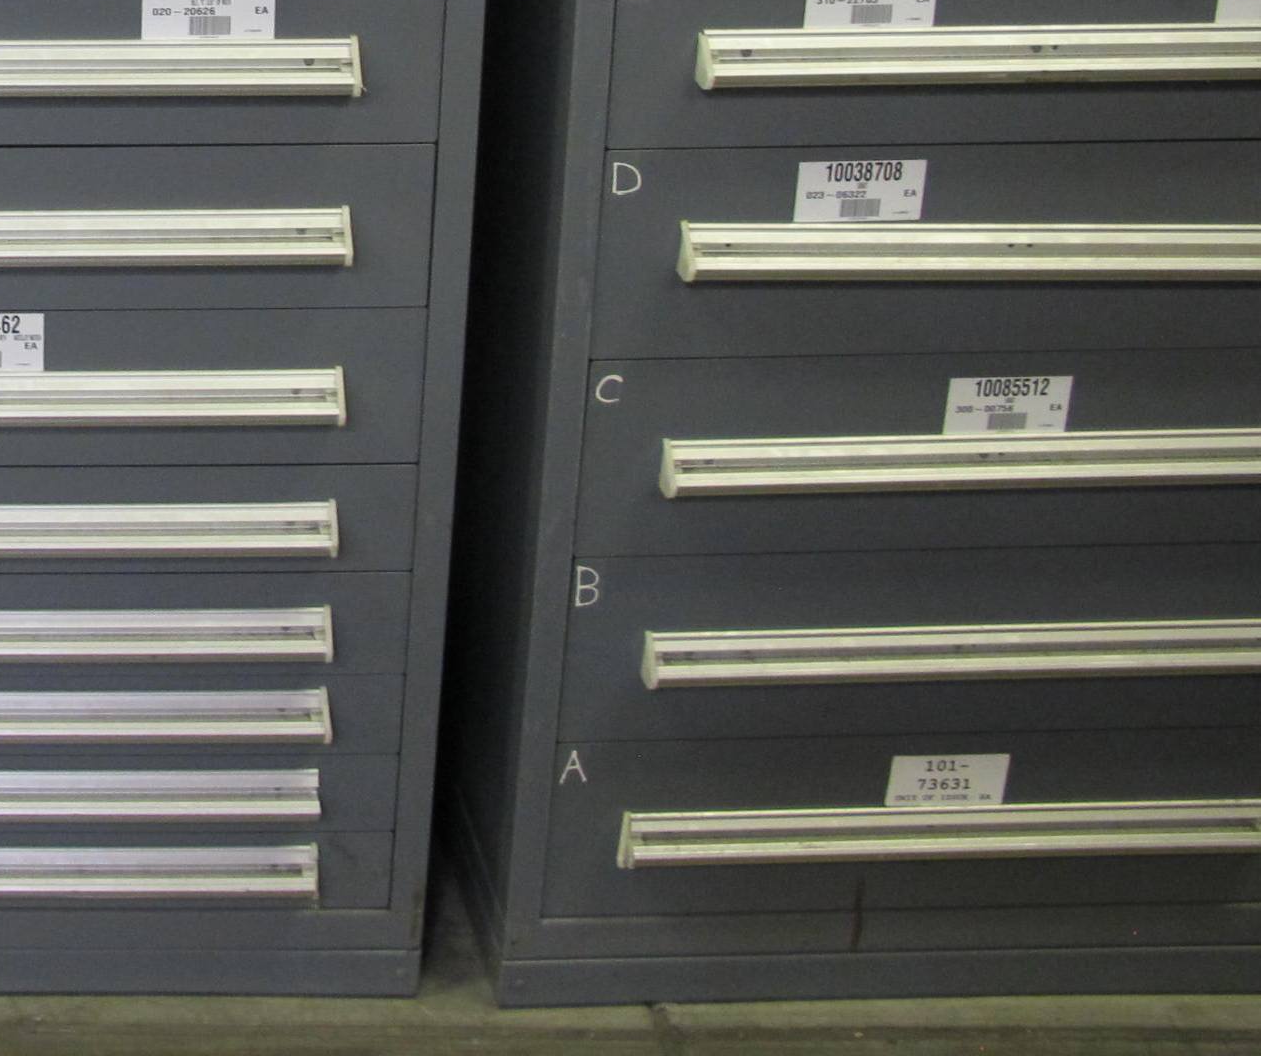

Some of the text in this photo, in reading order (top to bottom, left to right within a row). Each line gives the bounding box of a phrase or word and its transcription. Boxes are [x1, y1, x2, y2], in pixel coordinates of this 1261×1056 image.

[255, 6, 269, 15] EA
[611, 162, 642, 195] D
[826, 162, 903, 183] 10038708
[903, 189, 917, 197] EA
[24, 342, 38, 350] EA
[595, 374, 624, 403] C
[975, 378, 1051, 397] 10085512
[575, 565, 600, 607] B
[559, 749, 587, 784] A
[917, 778, 972, 791] 73631
